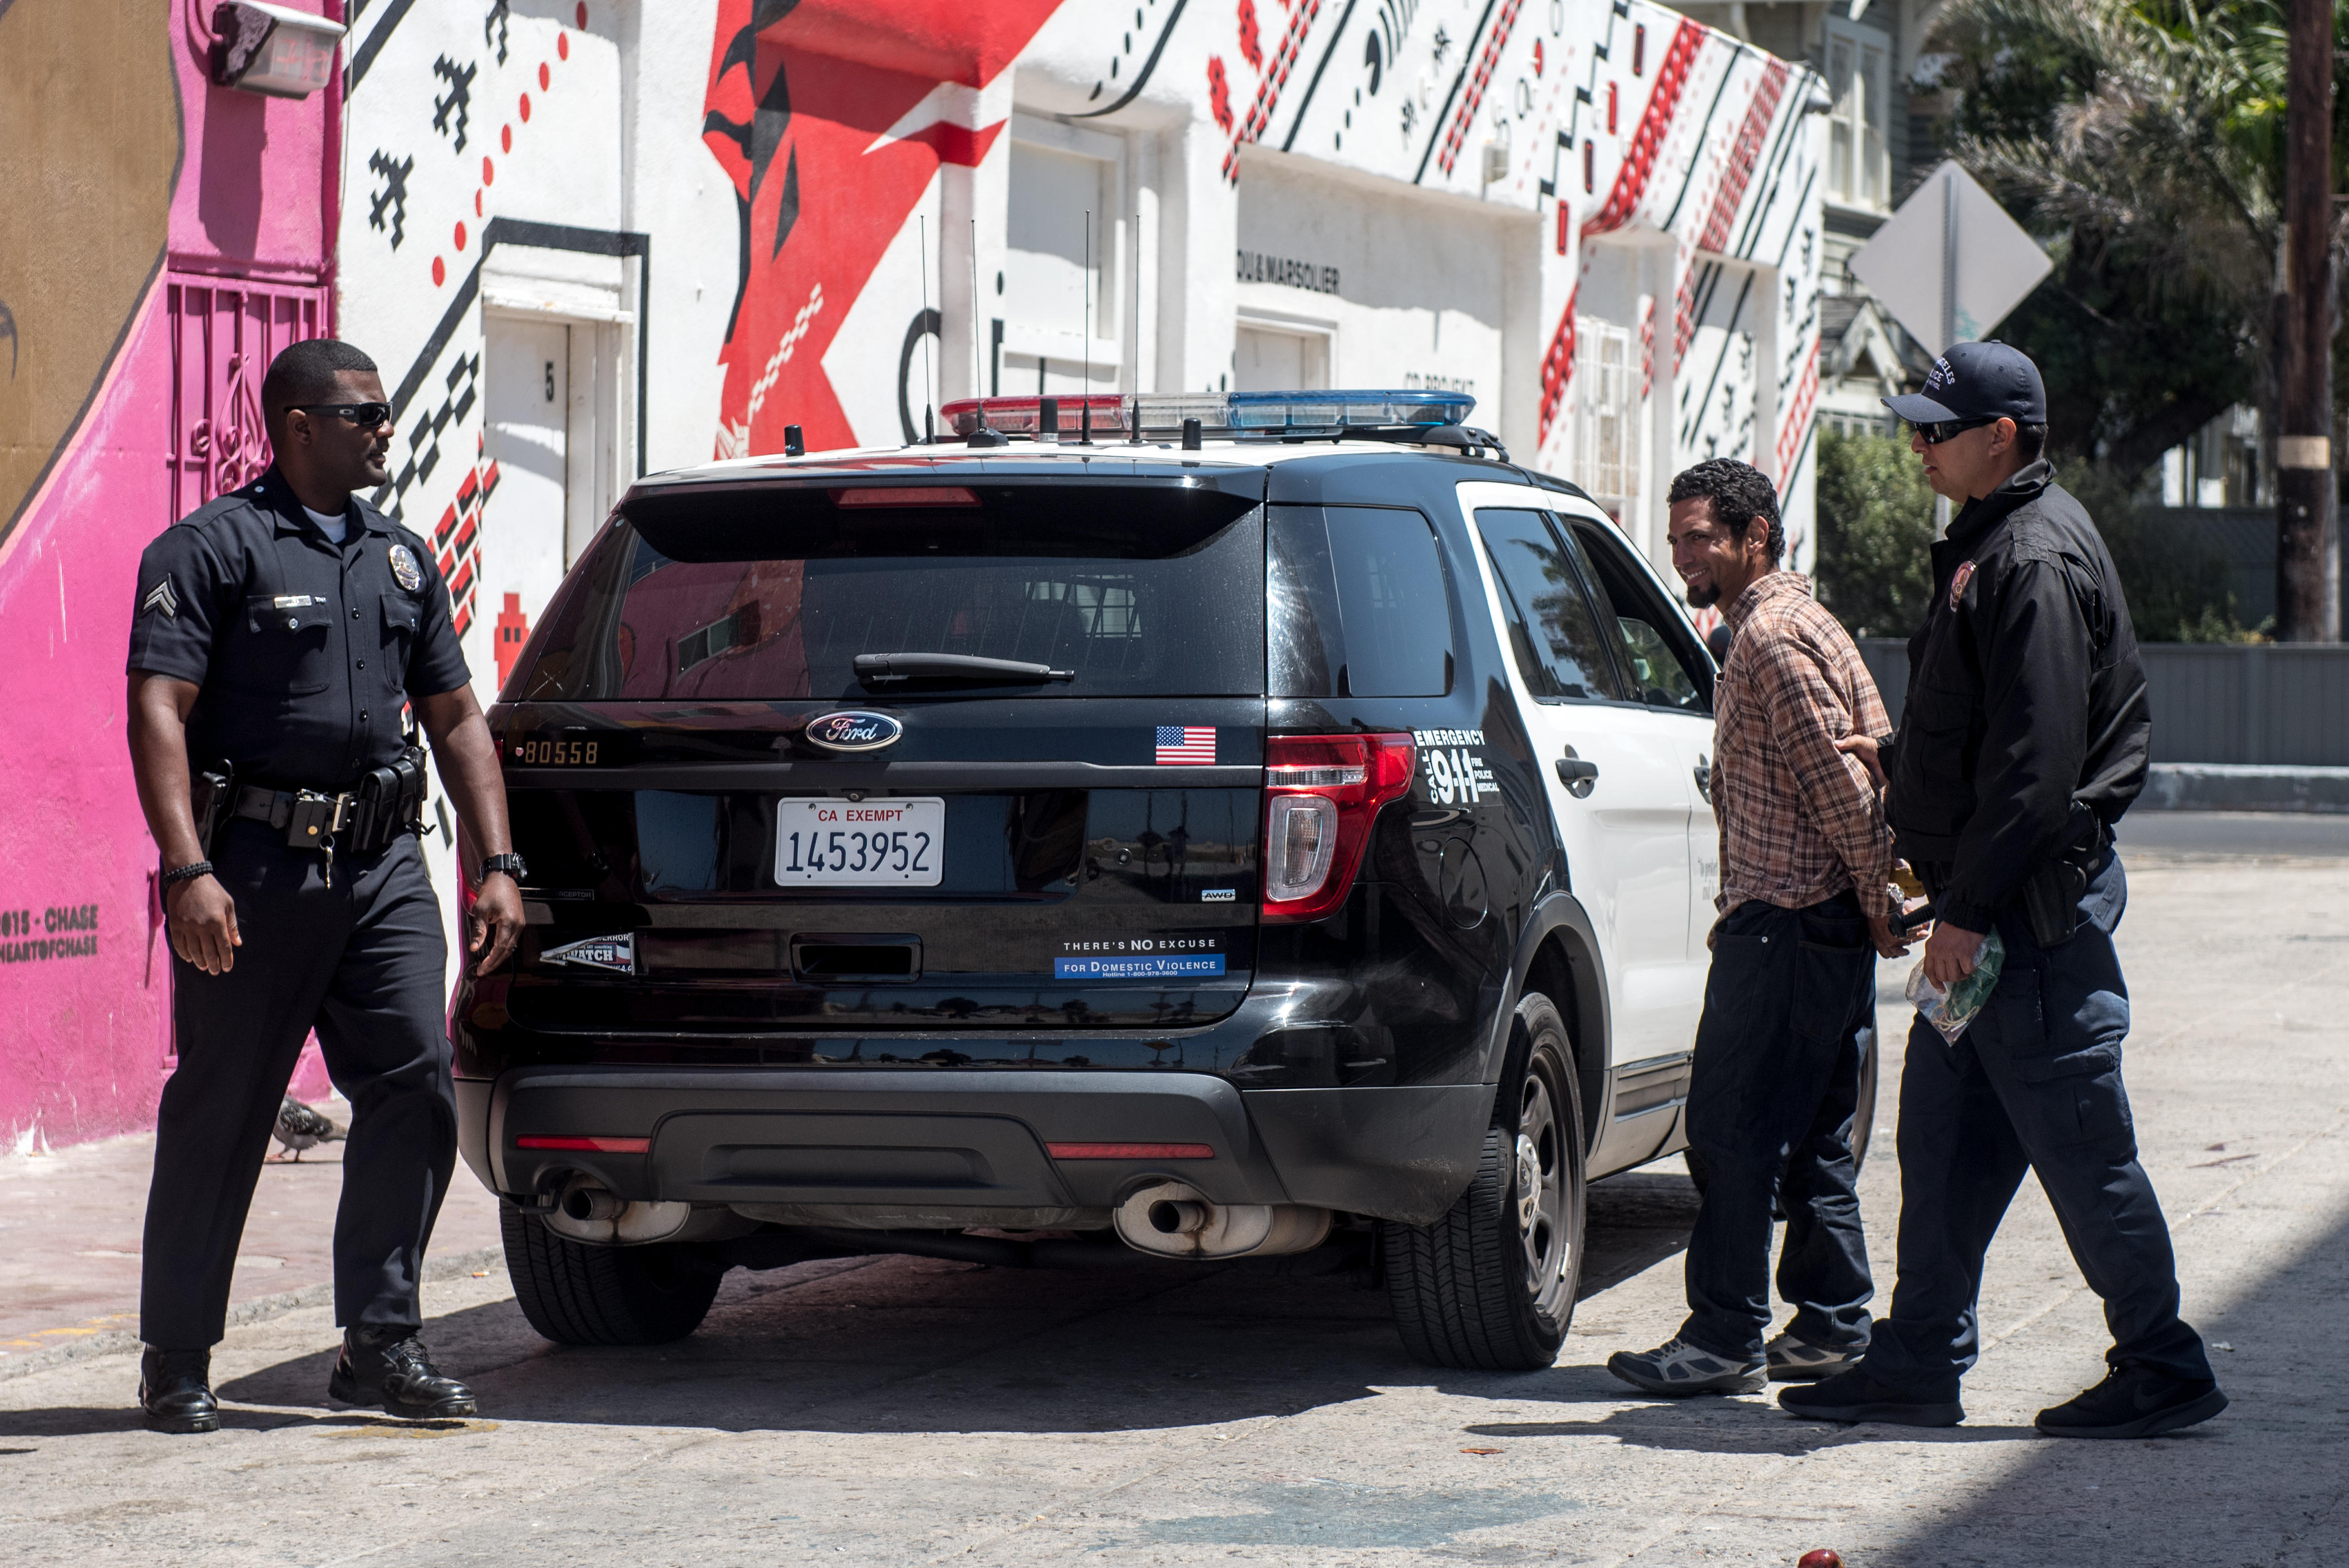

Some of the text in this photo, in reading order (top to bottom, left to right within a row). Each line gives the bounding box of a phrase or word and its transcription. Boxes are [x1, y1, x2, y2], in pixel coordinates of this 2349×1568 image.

[545, 361, 554, 402] 5
[826, 718, 878, 741] Ford
[1414, 729, 1485, 746] EMERGENCY
[525, 741, 598, 764] 80558
[1470, 757, 1483, 767] FIRE
[1421, 750, 1439, 804] CALL
[1474, 770, 1493, 780] POLICE
[1476, 782, 1500, 792] MEDICAL
[818, 810, 903, 821] CA EXEMPT
[786, 832, 930, 872] 1453952
[0, 904, 99, 938] 015 CHASE
[1064, 939, 1215, 950] THERE'S NO EXCUSE
[1091, 961, 1152, 972] DOMESTIC
[1157, 960, 1216, 970] VIOLENCE
